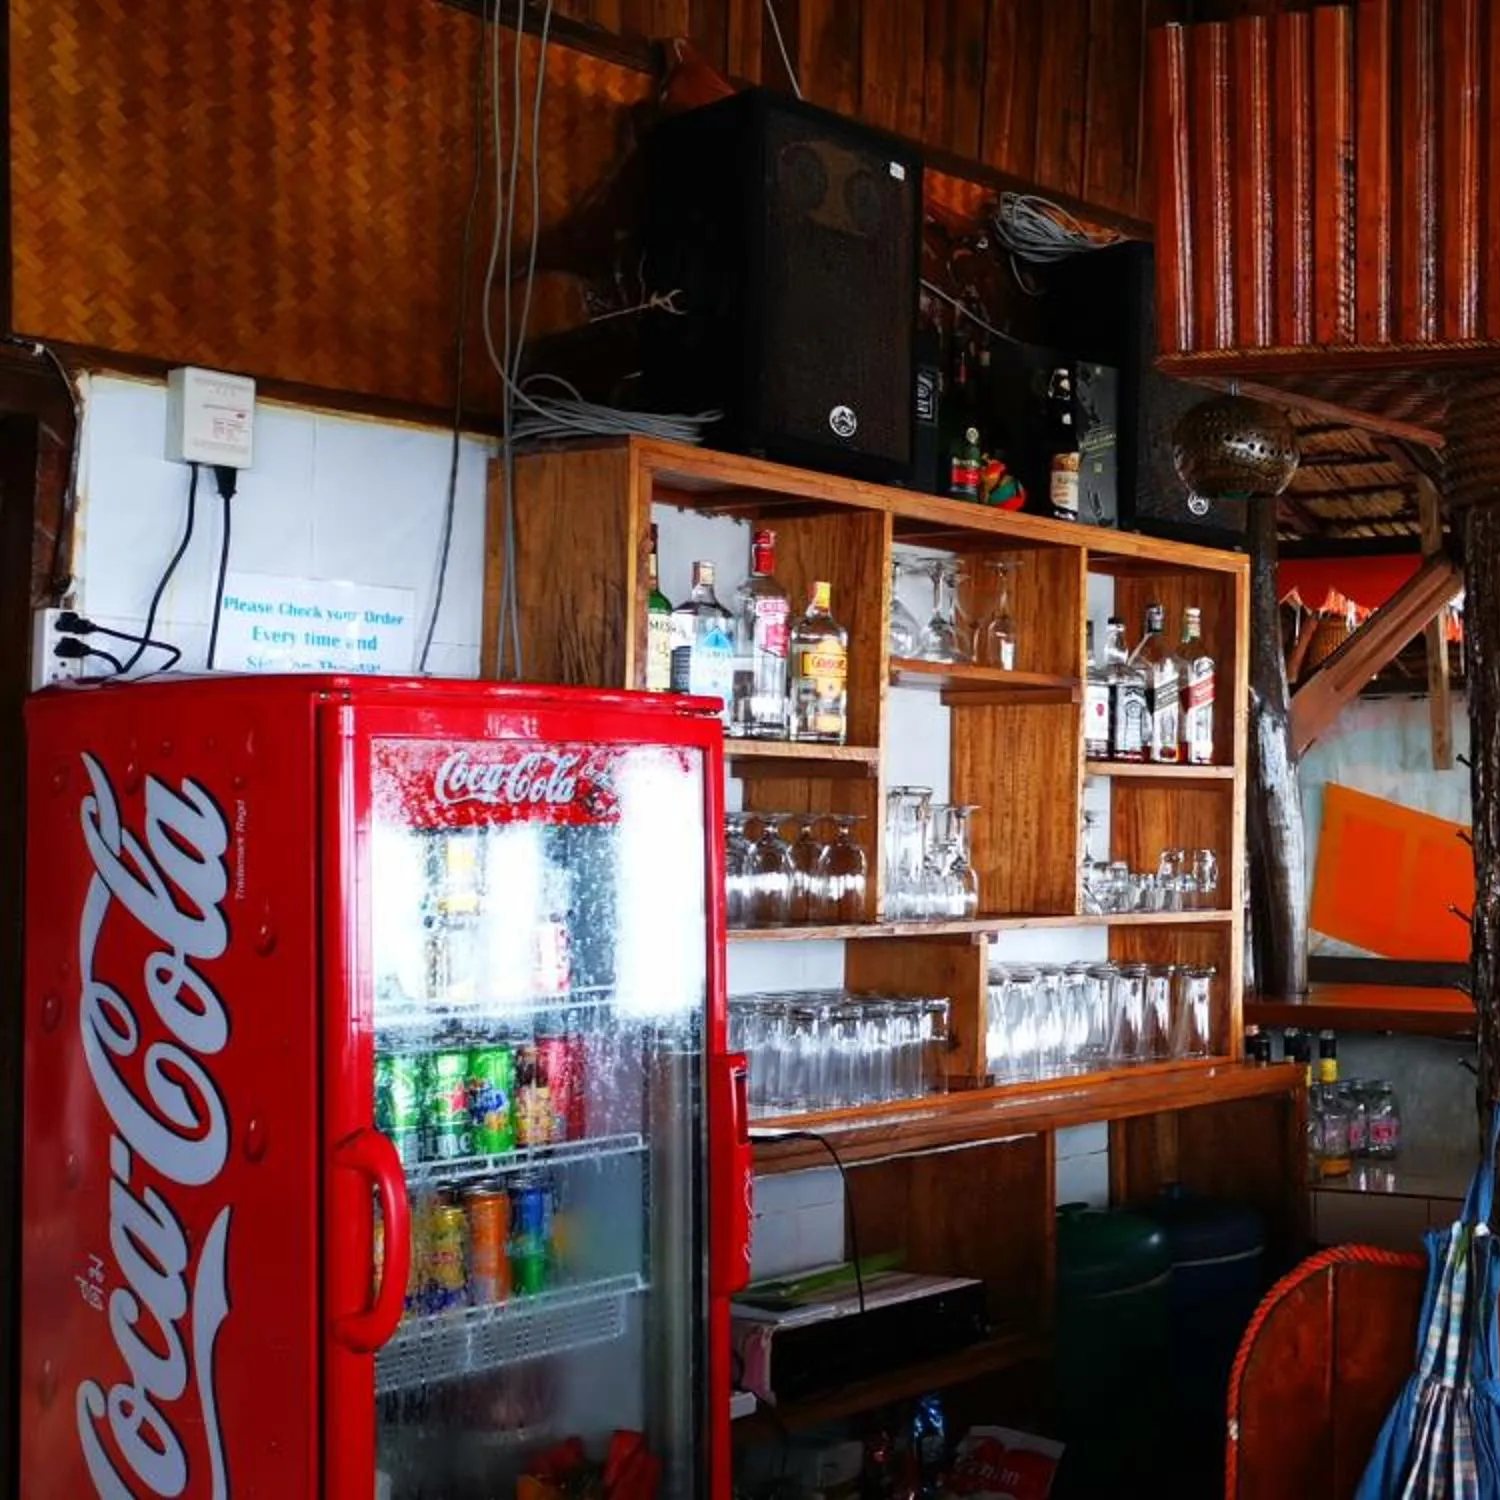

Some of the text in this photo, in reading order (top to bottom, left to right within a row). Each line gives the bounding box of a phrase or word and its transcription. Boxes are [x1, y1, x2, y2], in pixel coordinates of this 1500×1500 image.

[223, 596, 273, 614] Please
[279, 602, 323, 619] Check
[365, 611, 404, 625] Order
[253, 626, 296, 645] Every
[304, 631, 341, 648] time
[434, 752, 580, 804] Coca-Cola
